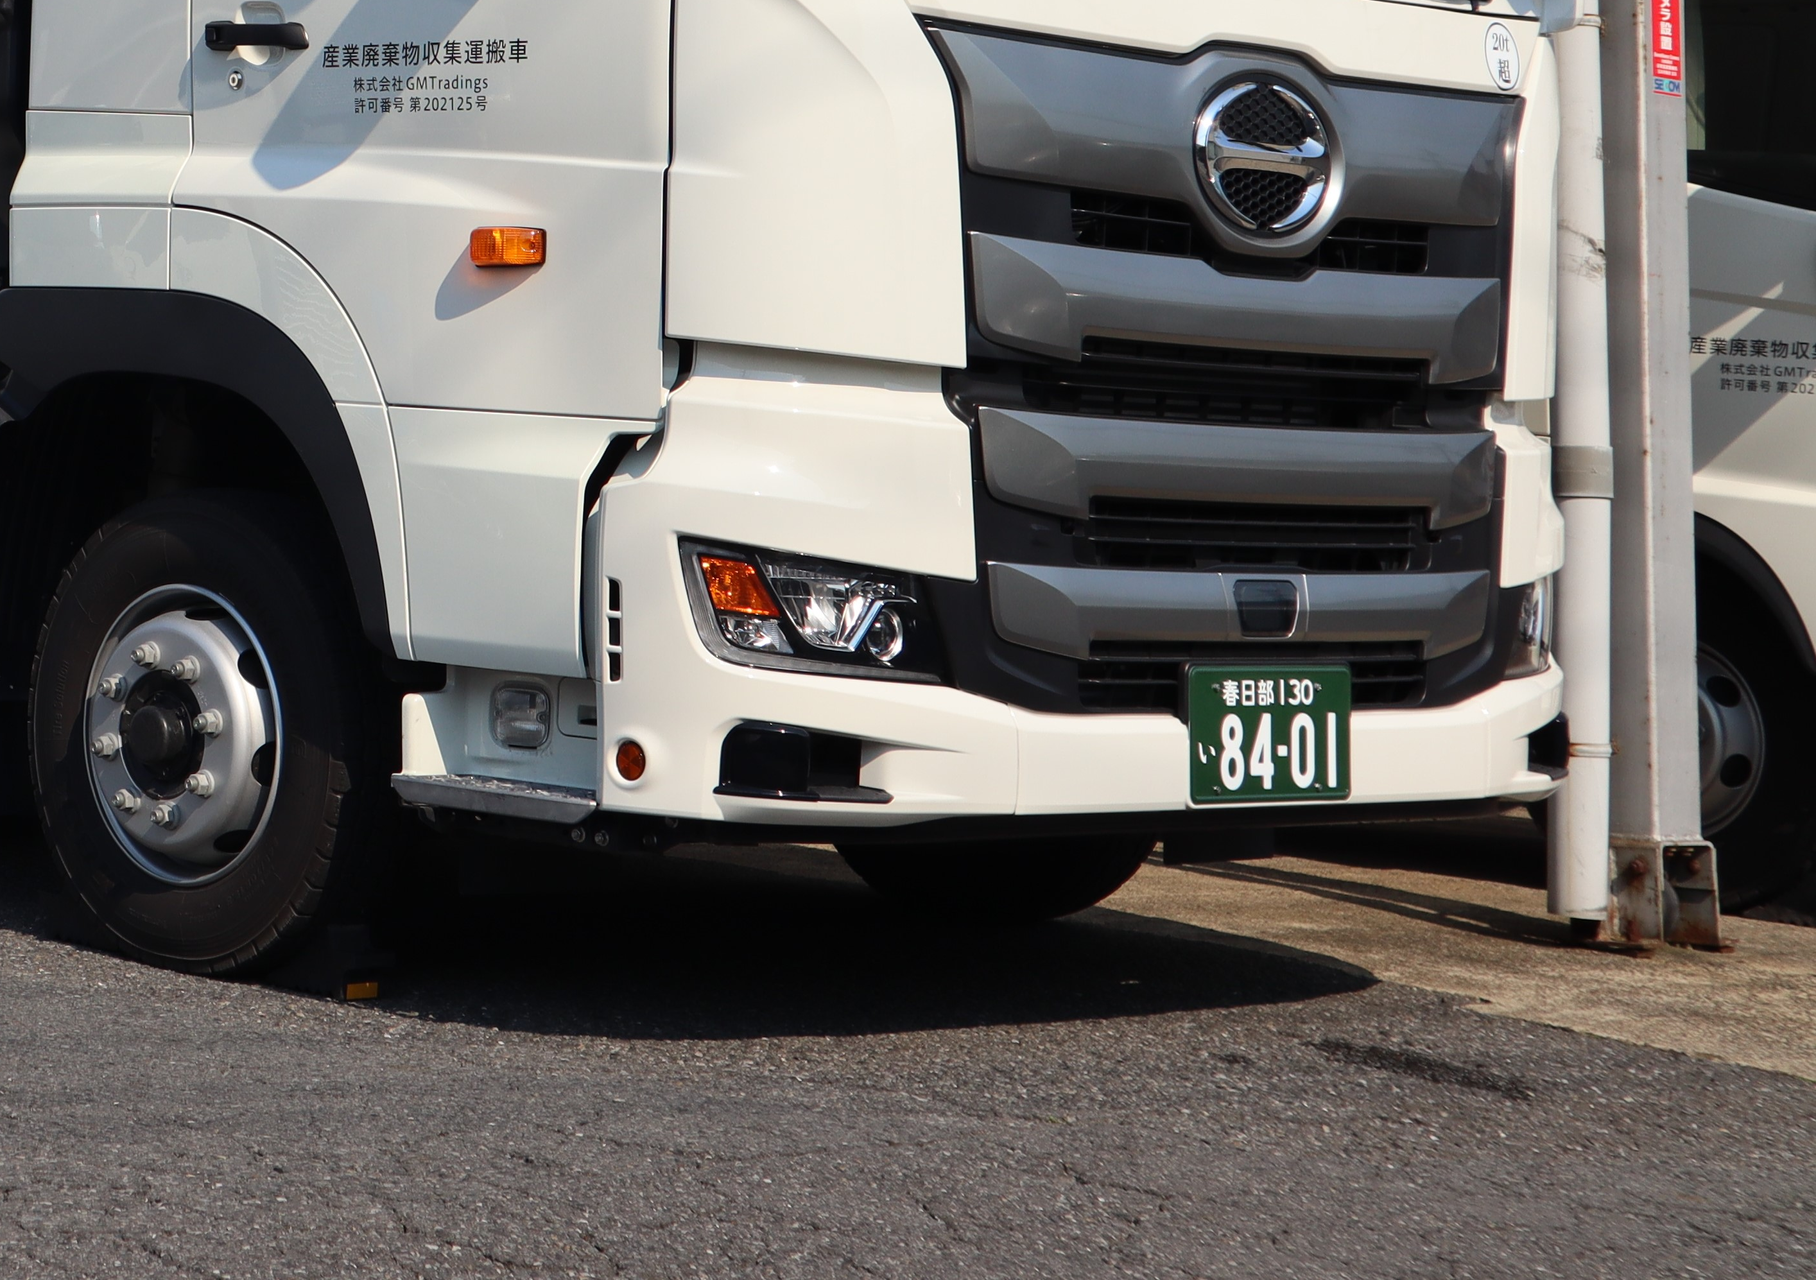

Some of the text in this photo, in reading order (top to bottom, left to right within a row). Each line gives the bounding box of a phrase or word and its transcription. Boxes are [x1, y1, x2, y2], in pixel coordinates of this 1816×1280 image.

[322, 38, 529, 69] 産業廃棄物収集運搬車
[1491, 32, 1510, 52] 20t
[1497, 58, 1511, 83] 超
[1222, 678, 1314, 707] 春日部 130
[1197, 712, 1338, 791] い 84-01
